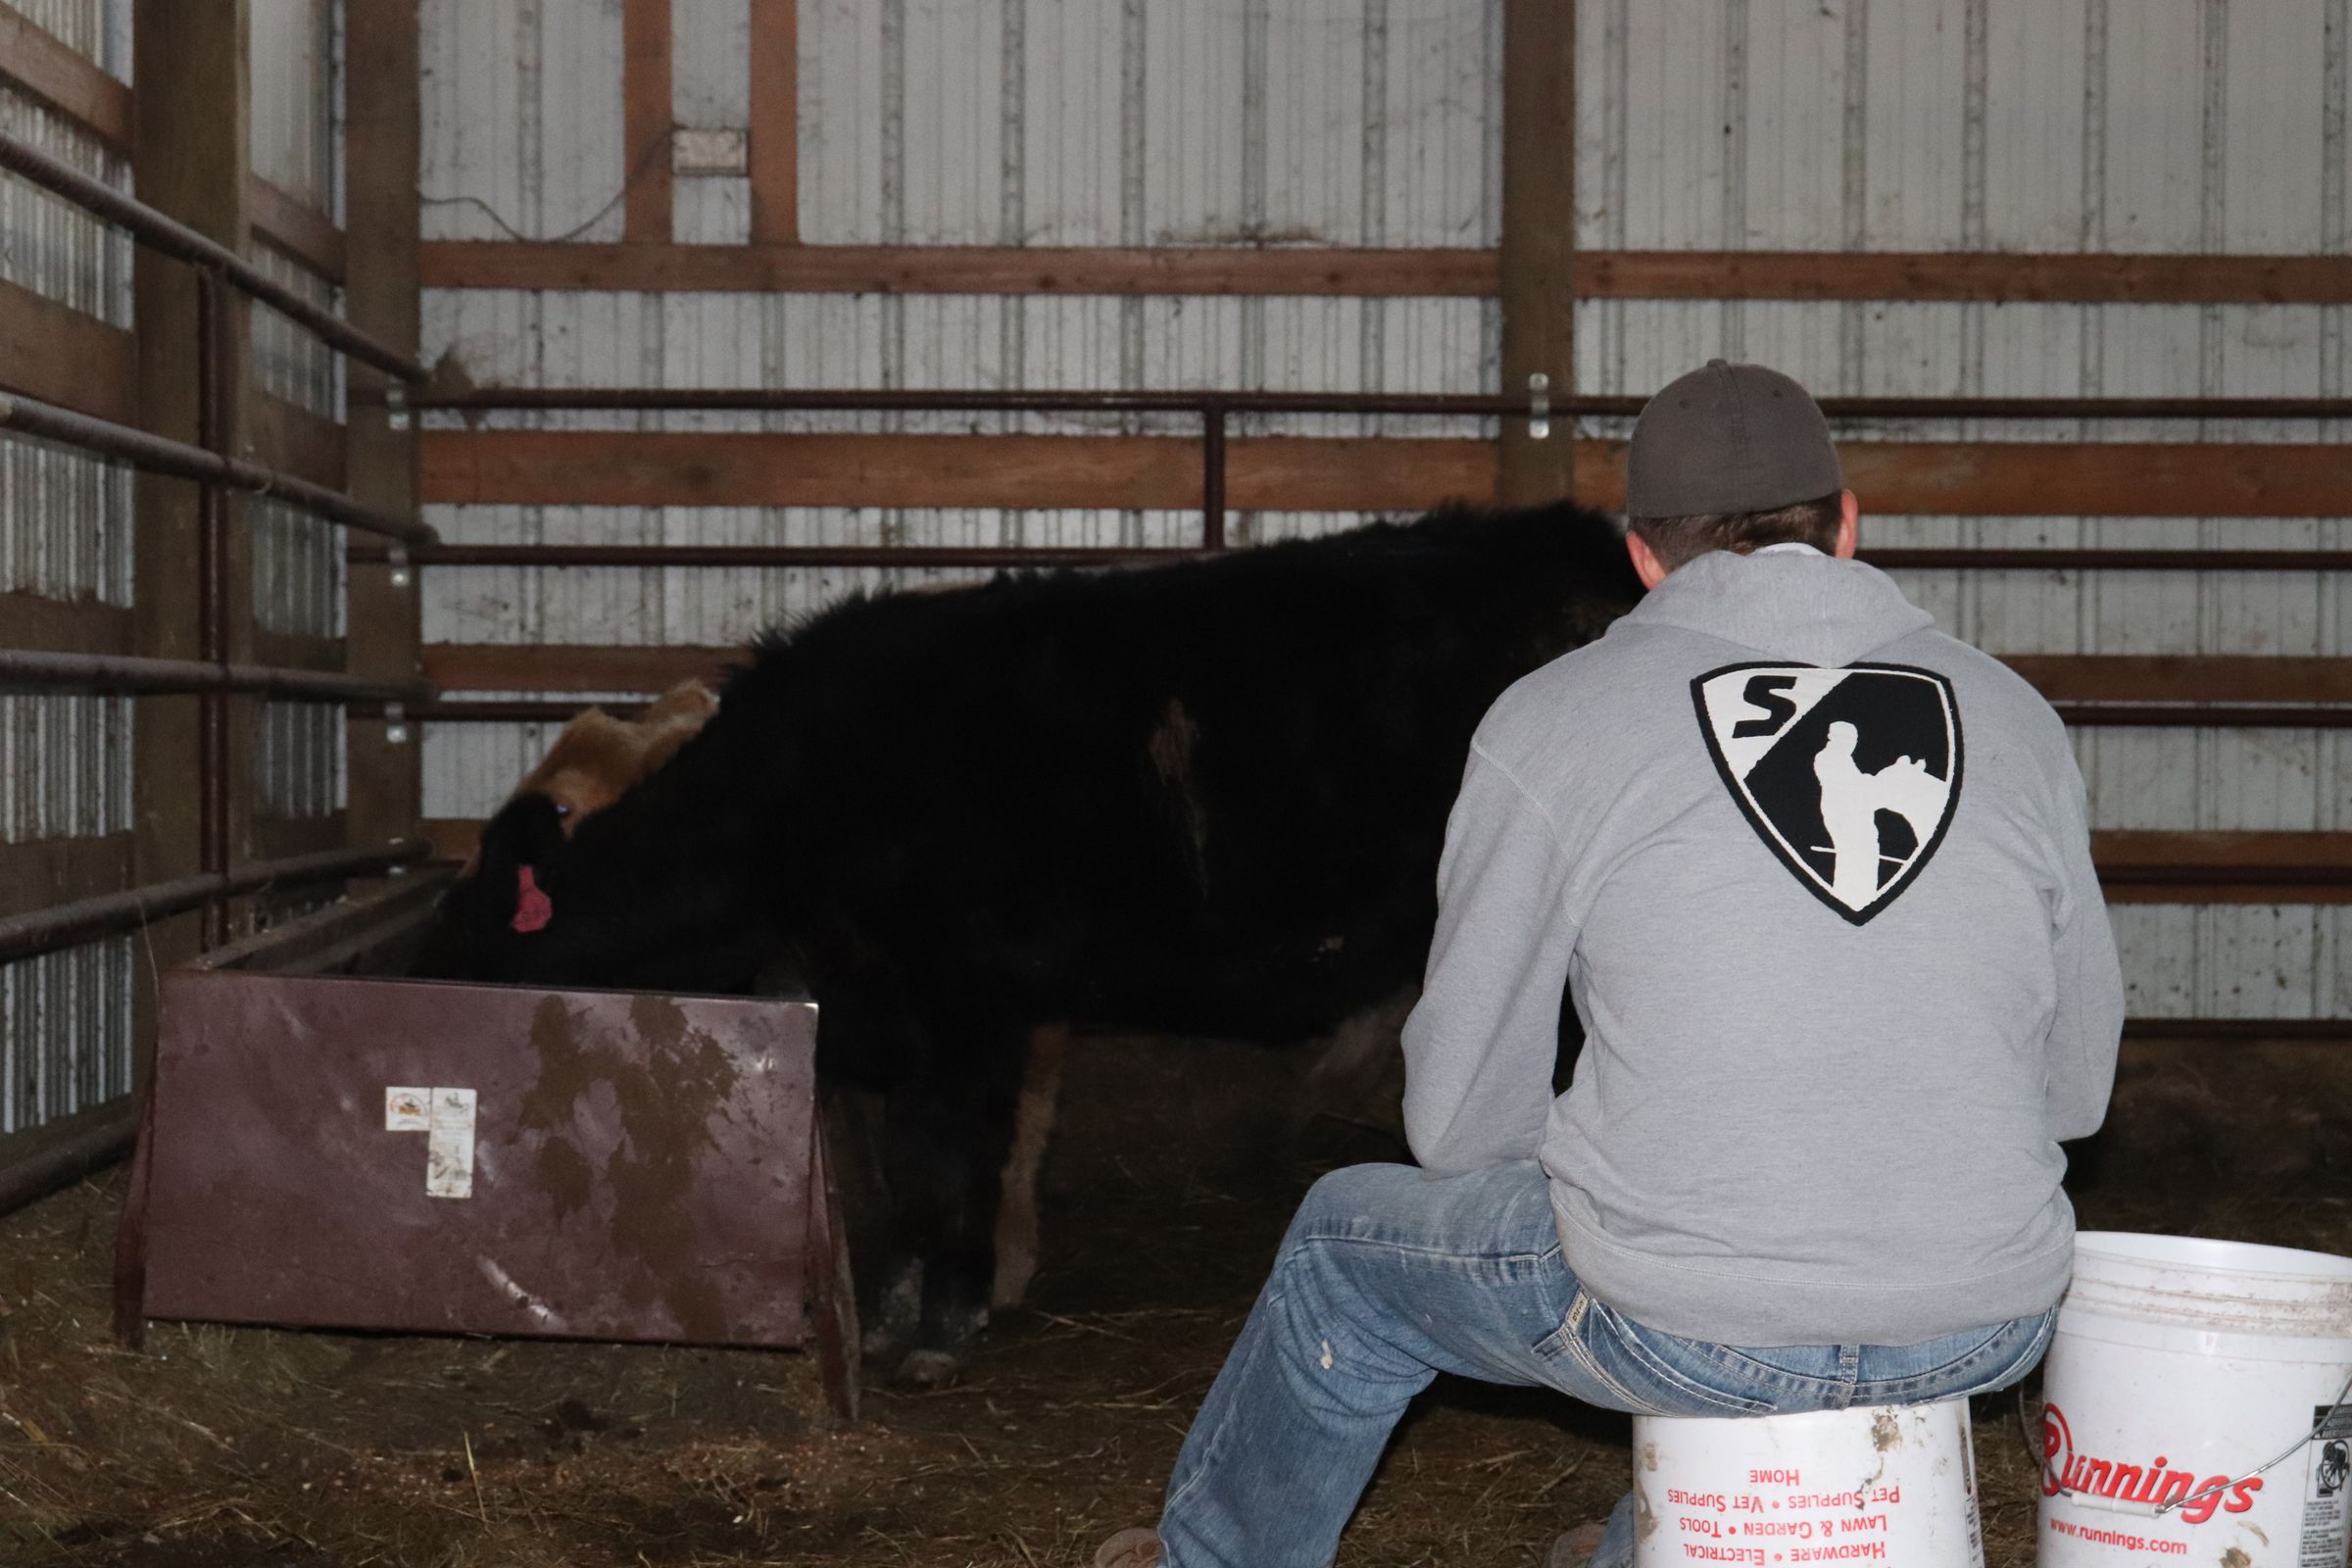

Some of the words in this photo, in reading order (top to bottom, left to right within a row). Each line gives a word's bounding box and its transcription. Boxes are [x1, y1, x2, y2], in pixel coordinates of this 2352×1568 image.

[1732, 674, 1798, 739] S
[1749, 1469, 1800, 1487] HOME
[1667, 1489, 1726, 1513] SUPPLIES
[1732, 1495, 1765, 1514] VET
[1679, 1517, 1723, 1539] TOOLS
[1743, 1522, 1813, 1540] GARDEN
[1821, 1520, 1834, 1537] &
[1841, 1514, 1887, 1532] LAWN
[2049, 1517, 2188, 1555] www.runnings.com
[1683, 1544, 1765, 1566] ELECTRICAL
[1790, 1542, 1886, 1560] HARDWARE
